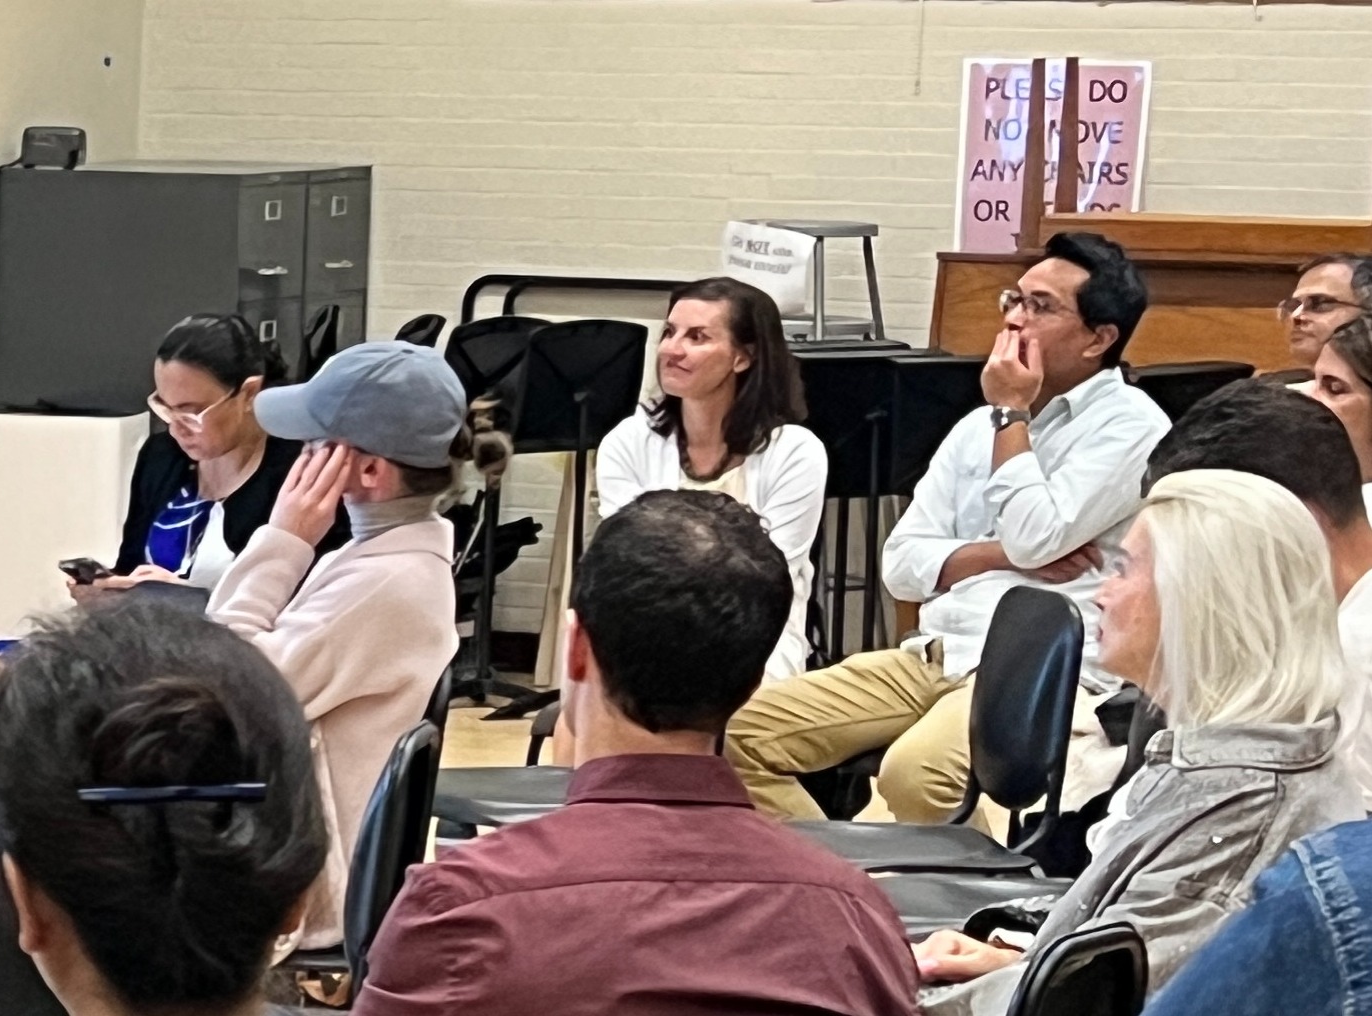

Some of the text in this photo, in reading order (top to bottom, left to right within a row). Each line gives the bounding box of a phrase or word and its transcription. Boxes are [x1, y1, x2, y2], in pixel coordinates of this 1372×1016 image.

[986, 77, 1128, 103] PLES DO
[970, 159, 1129, 185] ANY AIRS
[974, 199, 1010, 222] OR
